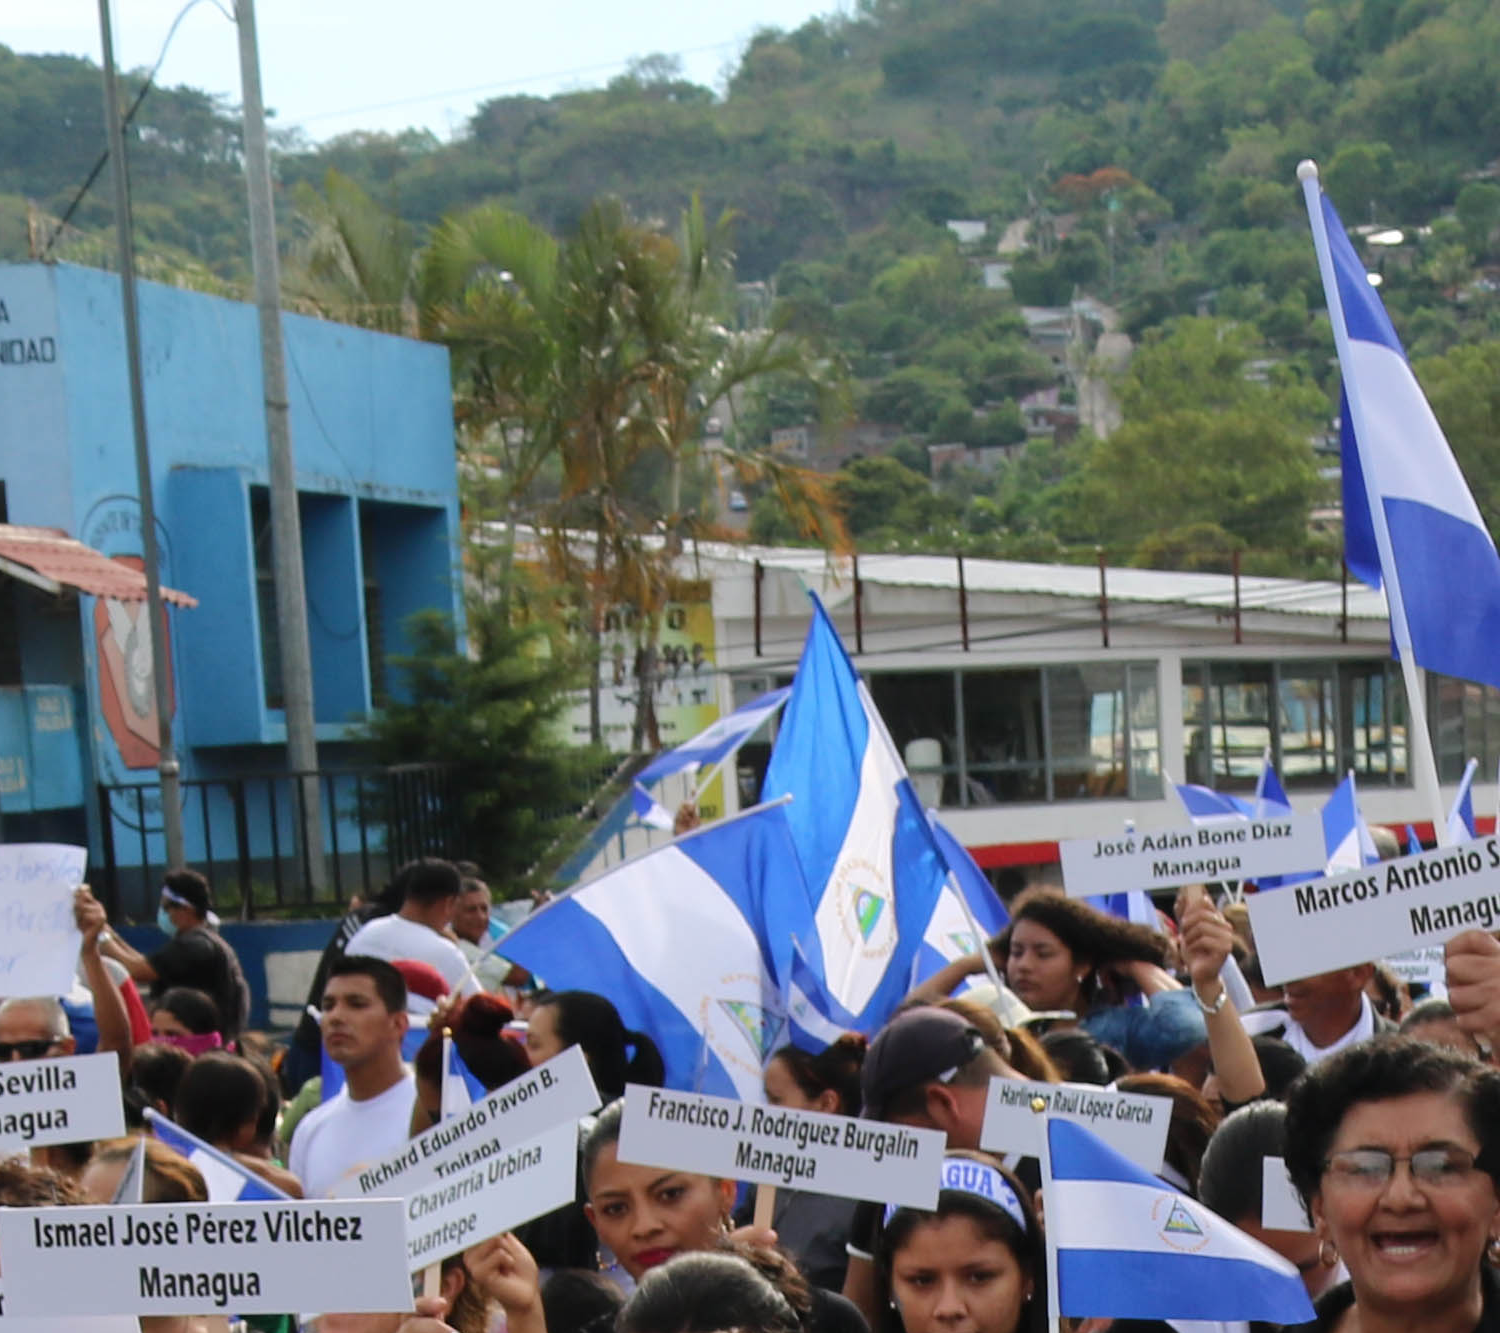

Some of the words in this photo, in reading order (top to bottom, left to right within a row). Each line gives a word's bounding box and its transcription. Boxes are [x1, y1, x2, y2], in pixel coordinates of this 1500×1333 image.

[1094, 832, 1137, 858] José
[1140, 827, 1195, 853] Adán
[1197, 824, 1247, 848] Bone
[1152, 854, 1242, 880] Managua
[1294, 875, 1379, 917] Marcos
[1385, 849, 1484, 896] Antonio
[647, 1091, 724, 1128] Francisco
[728, 1104, 748, 1132] J.
[1078, 1093, 1115, 1123] López
[358, 1141, 419, 1194] Richard
[419, 1111, 487, 1159] Eduardo
[487, 1079, 540, 1119] Pavón
[540, 1067, 560, 1091] B.
[486, 1144, 543, 1187] Urbina
[735, 1141, 817, 1181] Managua
[33, 1215, 116, 1249] Ismael
[121, 1211, 180, 1247] José
[185, 1210, 258, 1245] Pérez
[261, 1209, 364, 1244] Vilchez
[407, 1210, 478, 1260] uantepe
[138, 1266, 262, 1301] Managua
